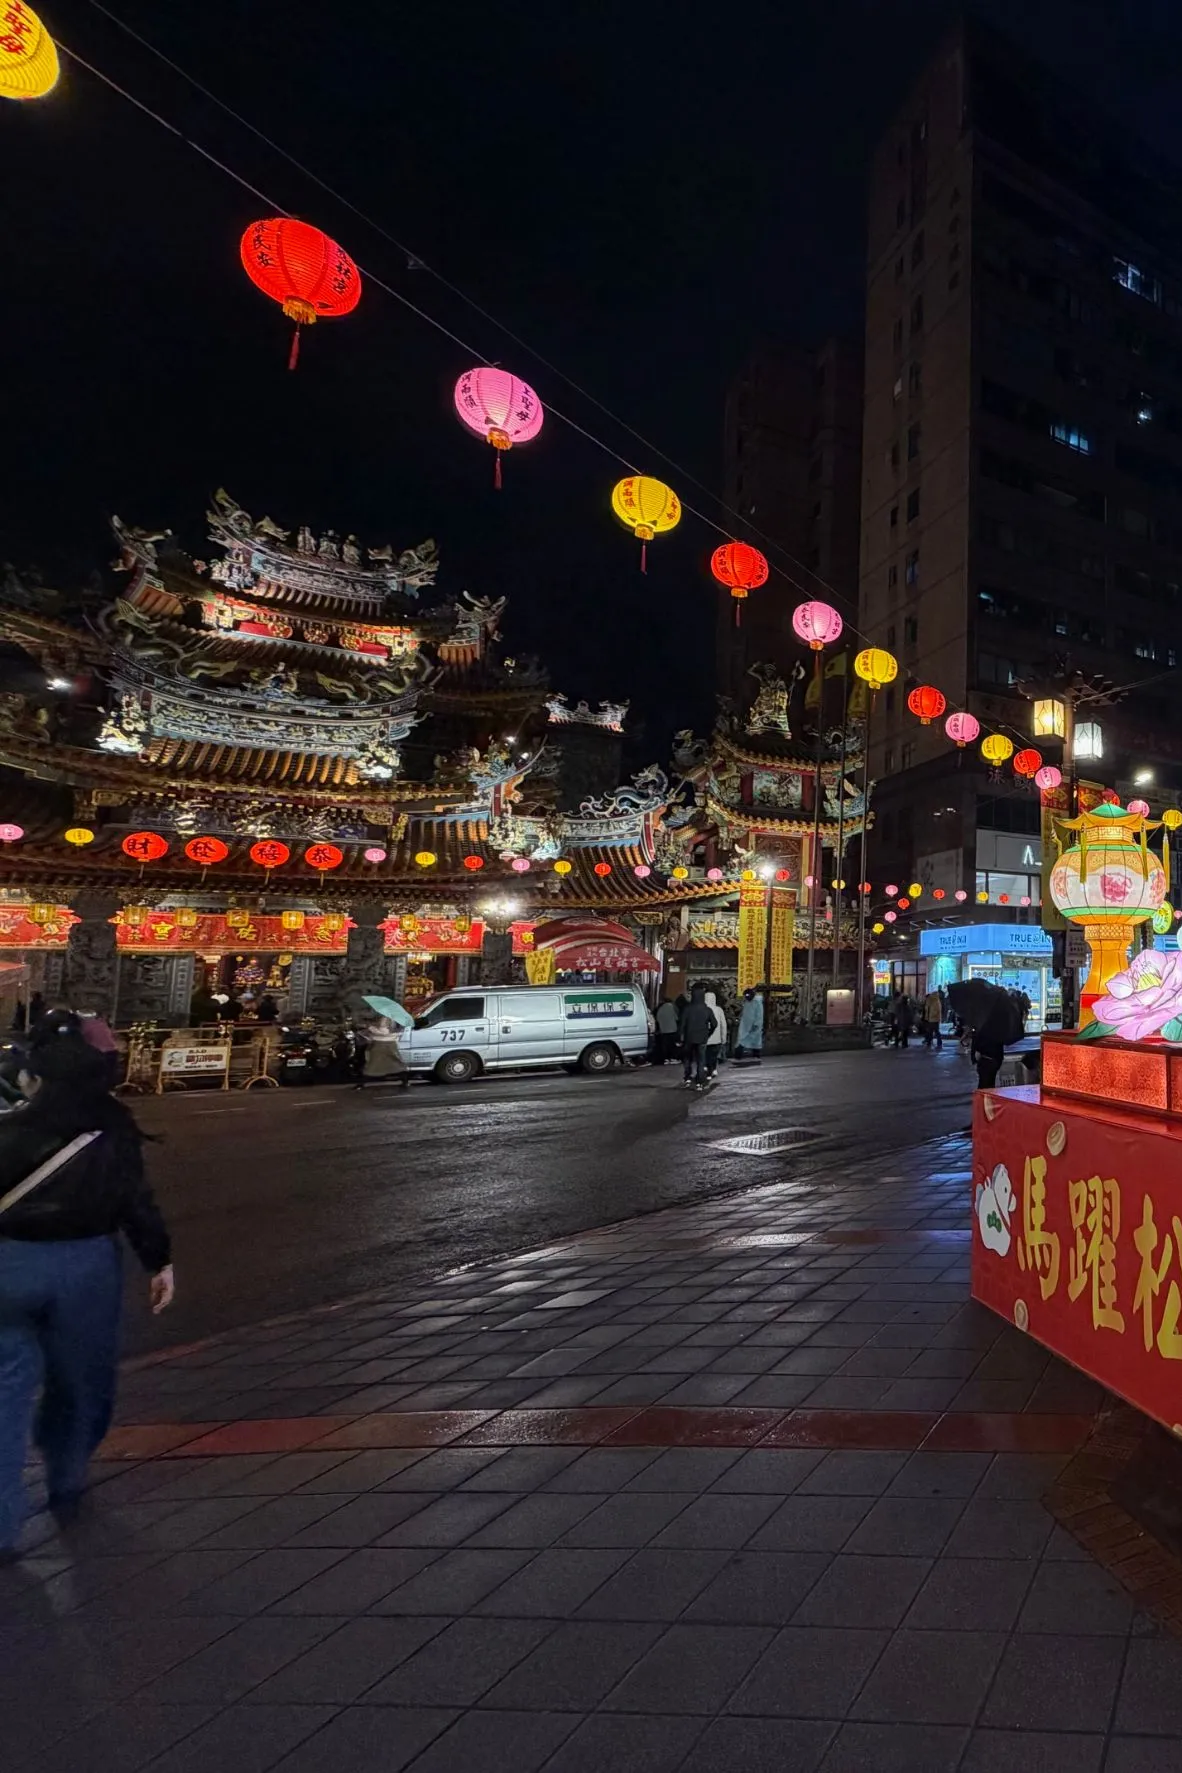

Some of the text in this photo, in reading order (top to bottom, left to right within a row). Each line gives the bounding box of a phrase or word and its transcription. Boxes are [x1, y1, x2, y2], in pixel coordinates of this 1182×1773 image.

[127, 838, 152, 854] 財
[312, 847, 335, 864] 恭
[440, 1029, 465, 1042] 737
